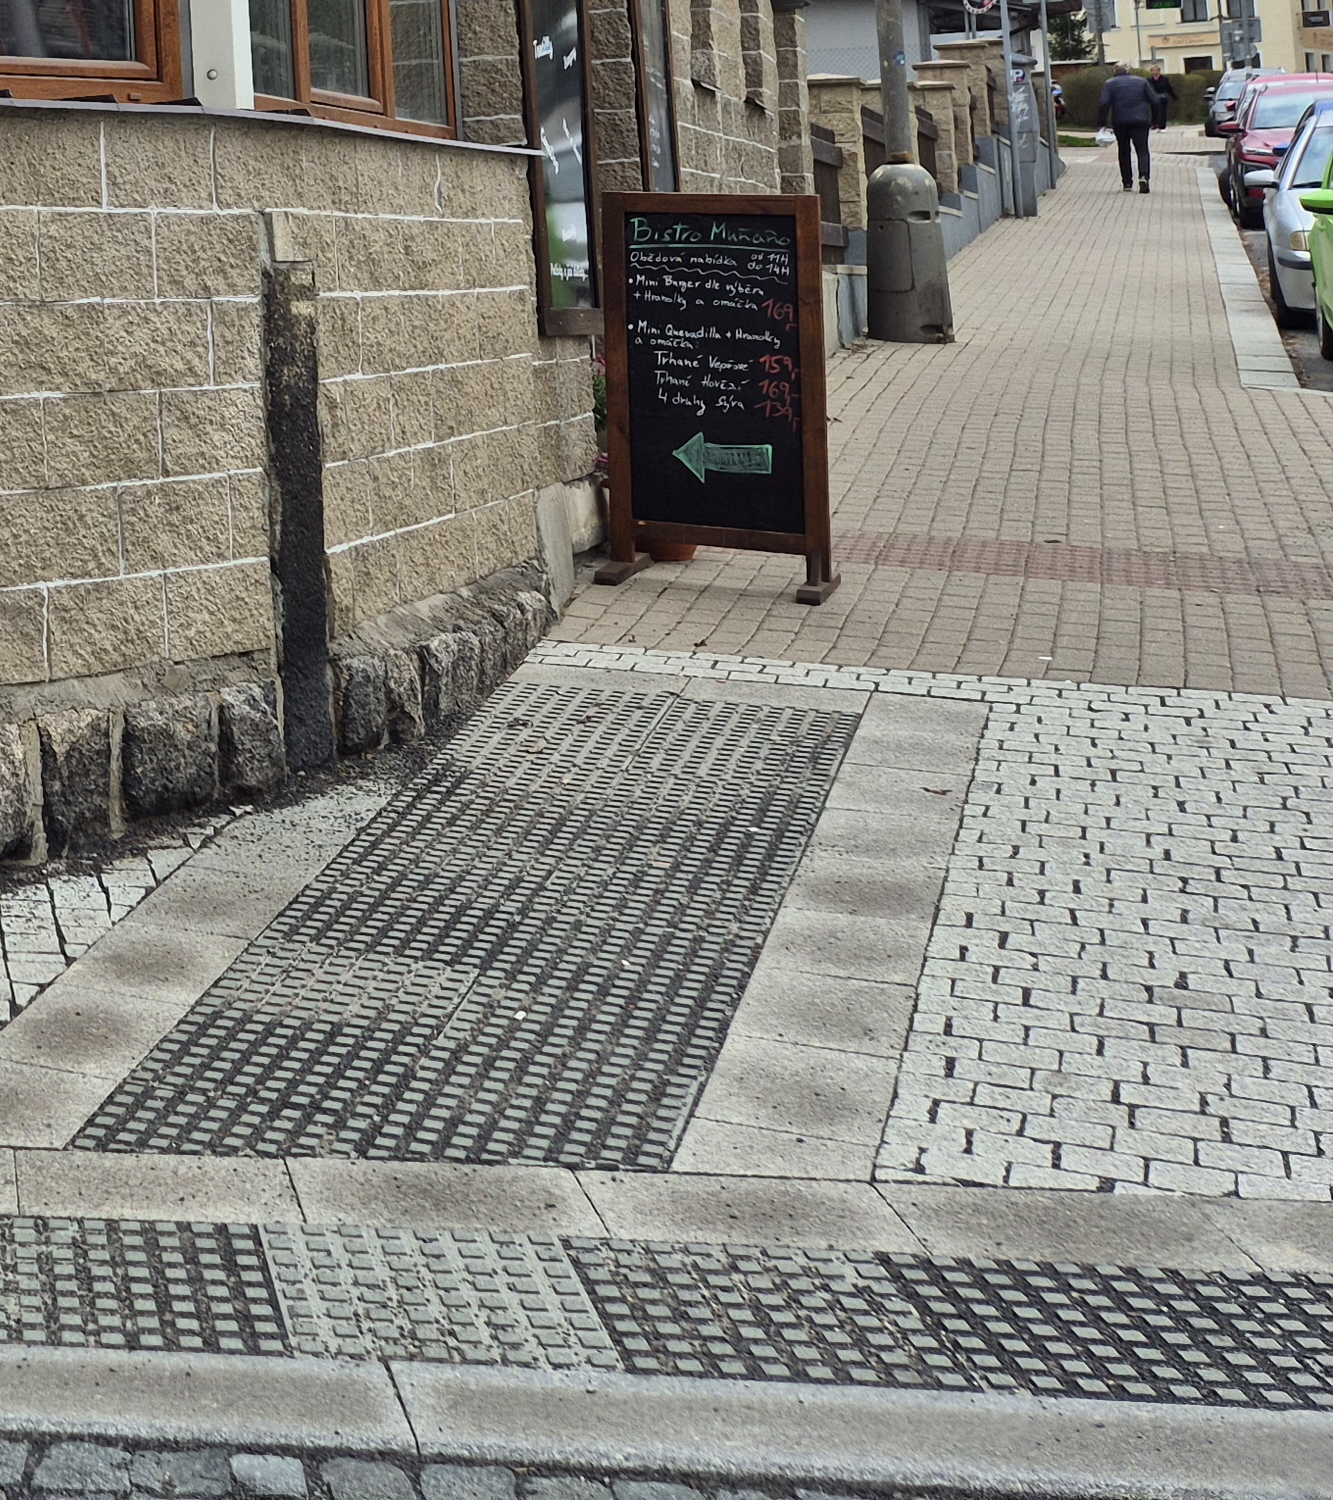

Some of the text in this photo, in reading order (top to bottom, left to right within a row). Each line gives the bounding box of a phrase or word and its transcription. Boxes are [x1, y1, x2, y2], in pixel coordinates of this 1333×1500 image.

[629, 217, 791, 246] Bistro Muñaño
[630, 251, 686, 263] Obědová
[689, 253, 738, 267] nabídka
[748, 262, 790, 276] do 14H
[635, 274, 659, 287] Mini
[705, 279, 721, 289] dle
[637, 319, 661, 335] Mini
[653, 350, 703, 368] Trhané
[654, 370, 693, 387] Trhané
[658, 387, 668, 404] 4
